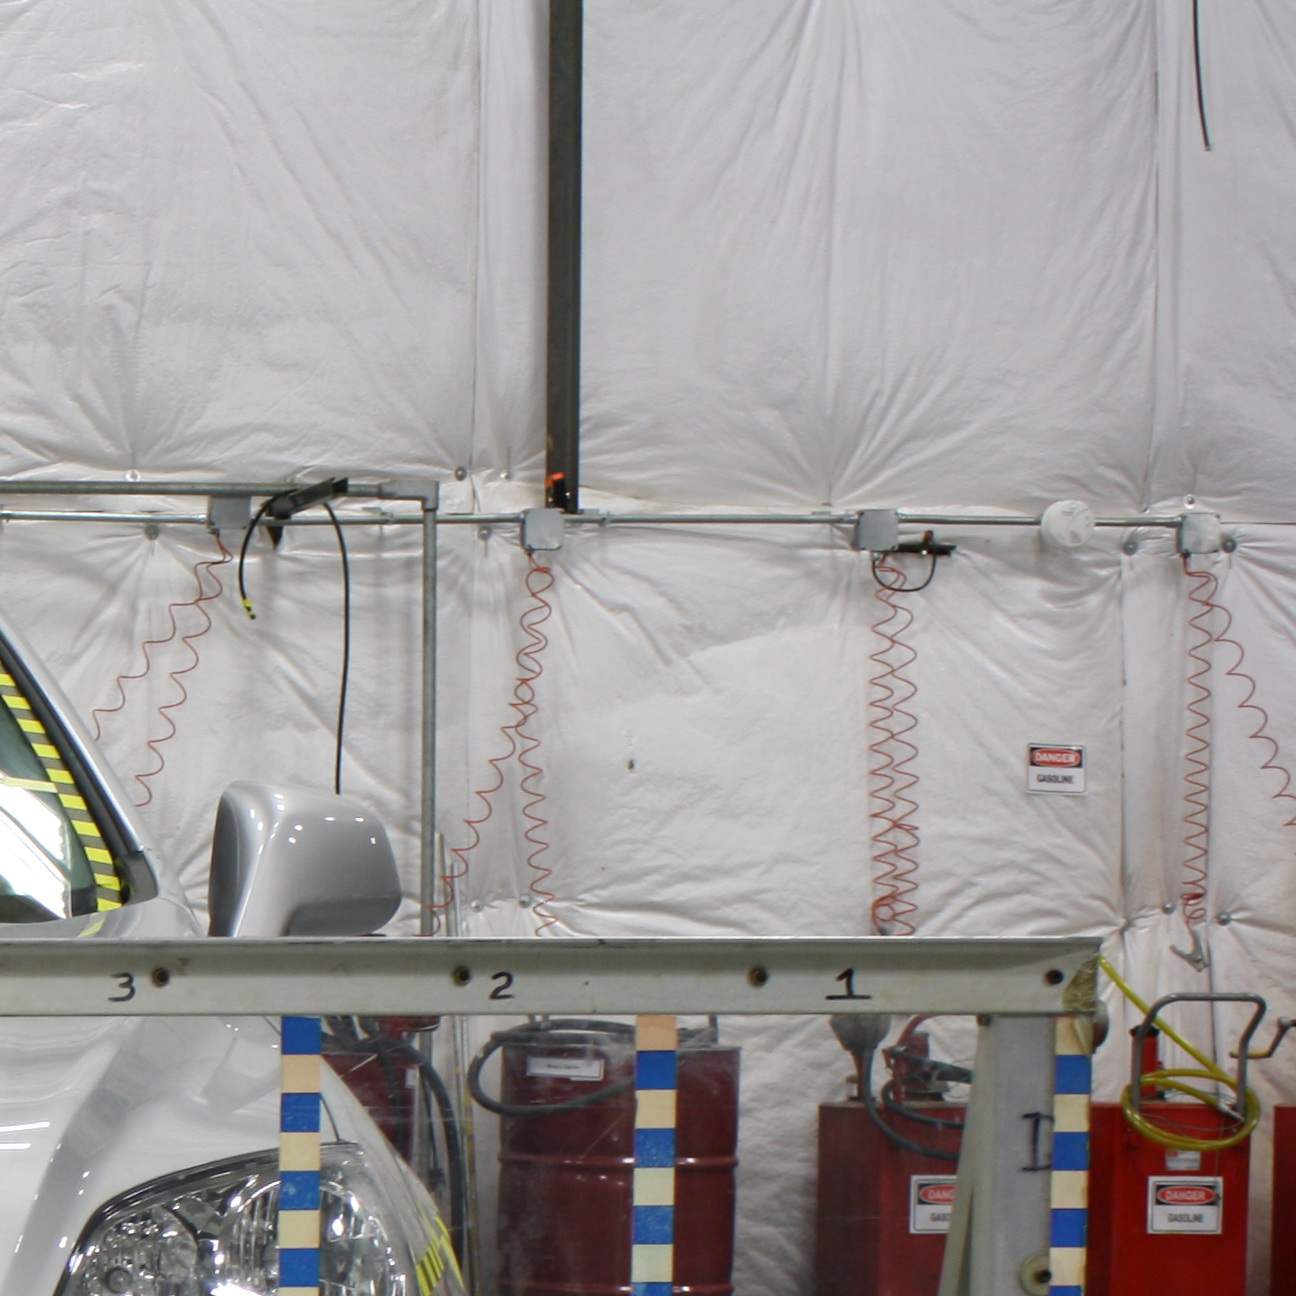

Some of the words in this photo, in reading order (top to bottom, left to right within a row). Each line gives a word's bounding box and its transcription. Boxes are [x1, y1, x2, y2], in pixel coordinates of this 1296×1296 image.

[1035, 752, 1076, 763] DANGER
[1036, 774, 1074, 784] GASOLINE
[108, 972, 137, 1002] 3
[488, 971, 515, 1000] 2
[825, 967, 871, 1001] 1
[927, 1189, 956, 1200] DANG
[1165, 1190, 1206, 1201] DANGER
[1167, 1213, 1204, 1224] GASOLINE
